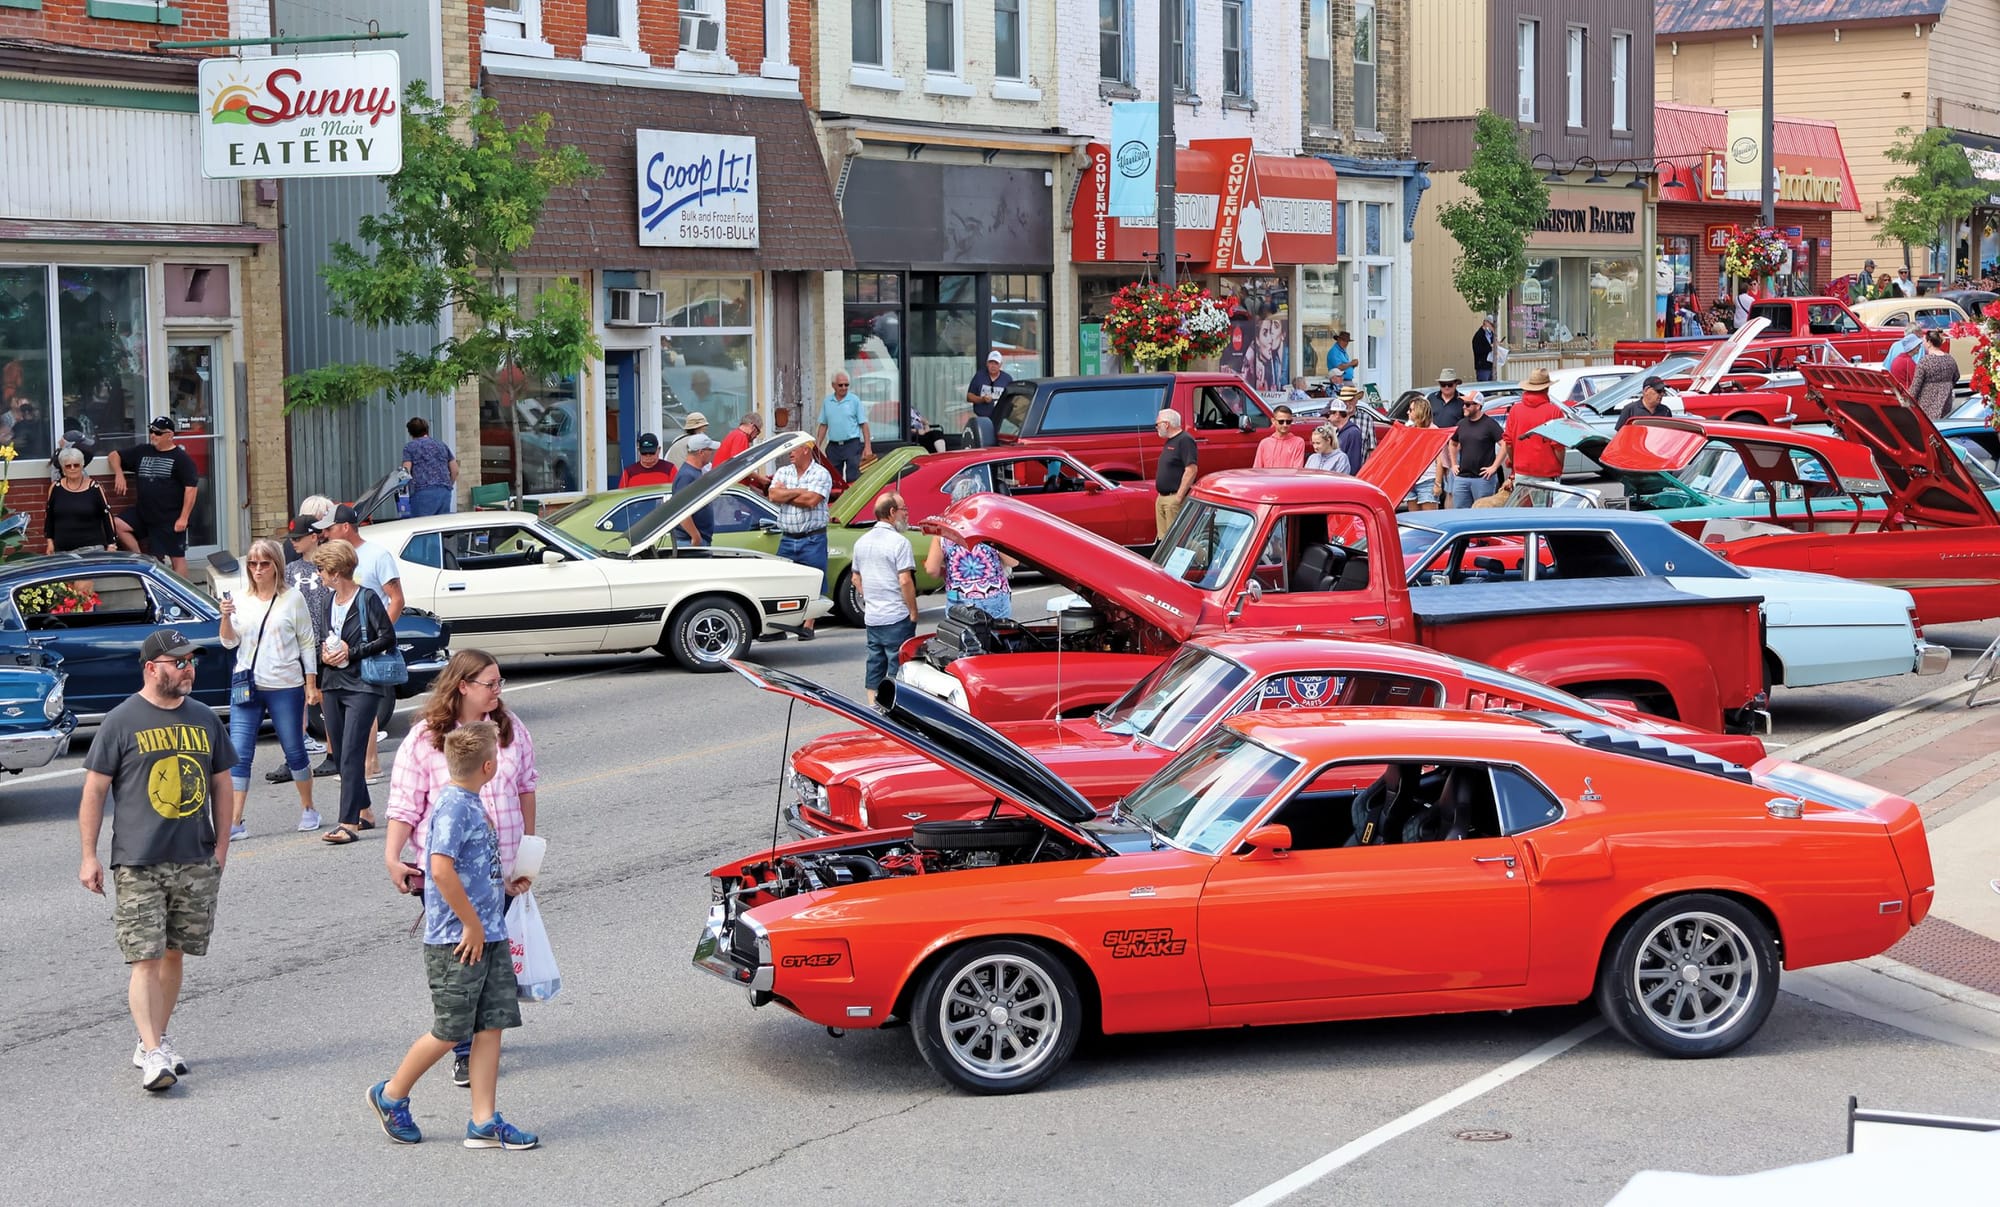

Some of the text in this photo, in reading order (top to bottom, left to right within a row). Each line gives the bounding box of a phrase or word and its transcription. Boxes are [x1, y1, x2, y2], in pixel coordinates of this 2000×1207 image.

[246, 68, 395, 127] Sunny
[300, 120, 363, 137] on Main
[229, 138, 374, 166] EATERY
[641, 149, 752, 218] Scoop It!
[1778, 165, 1842, 203] hardware
[681, 210, 754, 223] Bulk and Frozen Food
[1095, 153, 1106, 260] CONVENIENCE
[1215, 153, 1245, 269] CONVENIENCE
[679, 225, 756, 240] 519-510-BULK
[1265, 686, 1281, 695] OIL
[1302, 699, 1322, 707] PARTS
[134, 726, 211, 754] NIRVANA
[1103, 928, 1173, 947] SUPER
[1112, 938, 1187, 959] SNAKE
